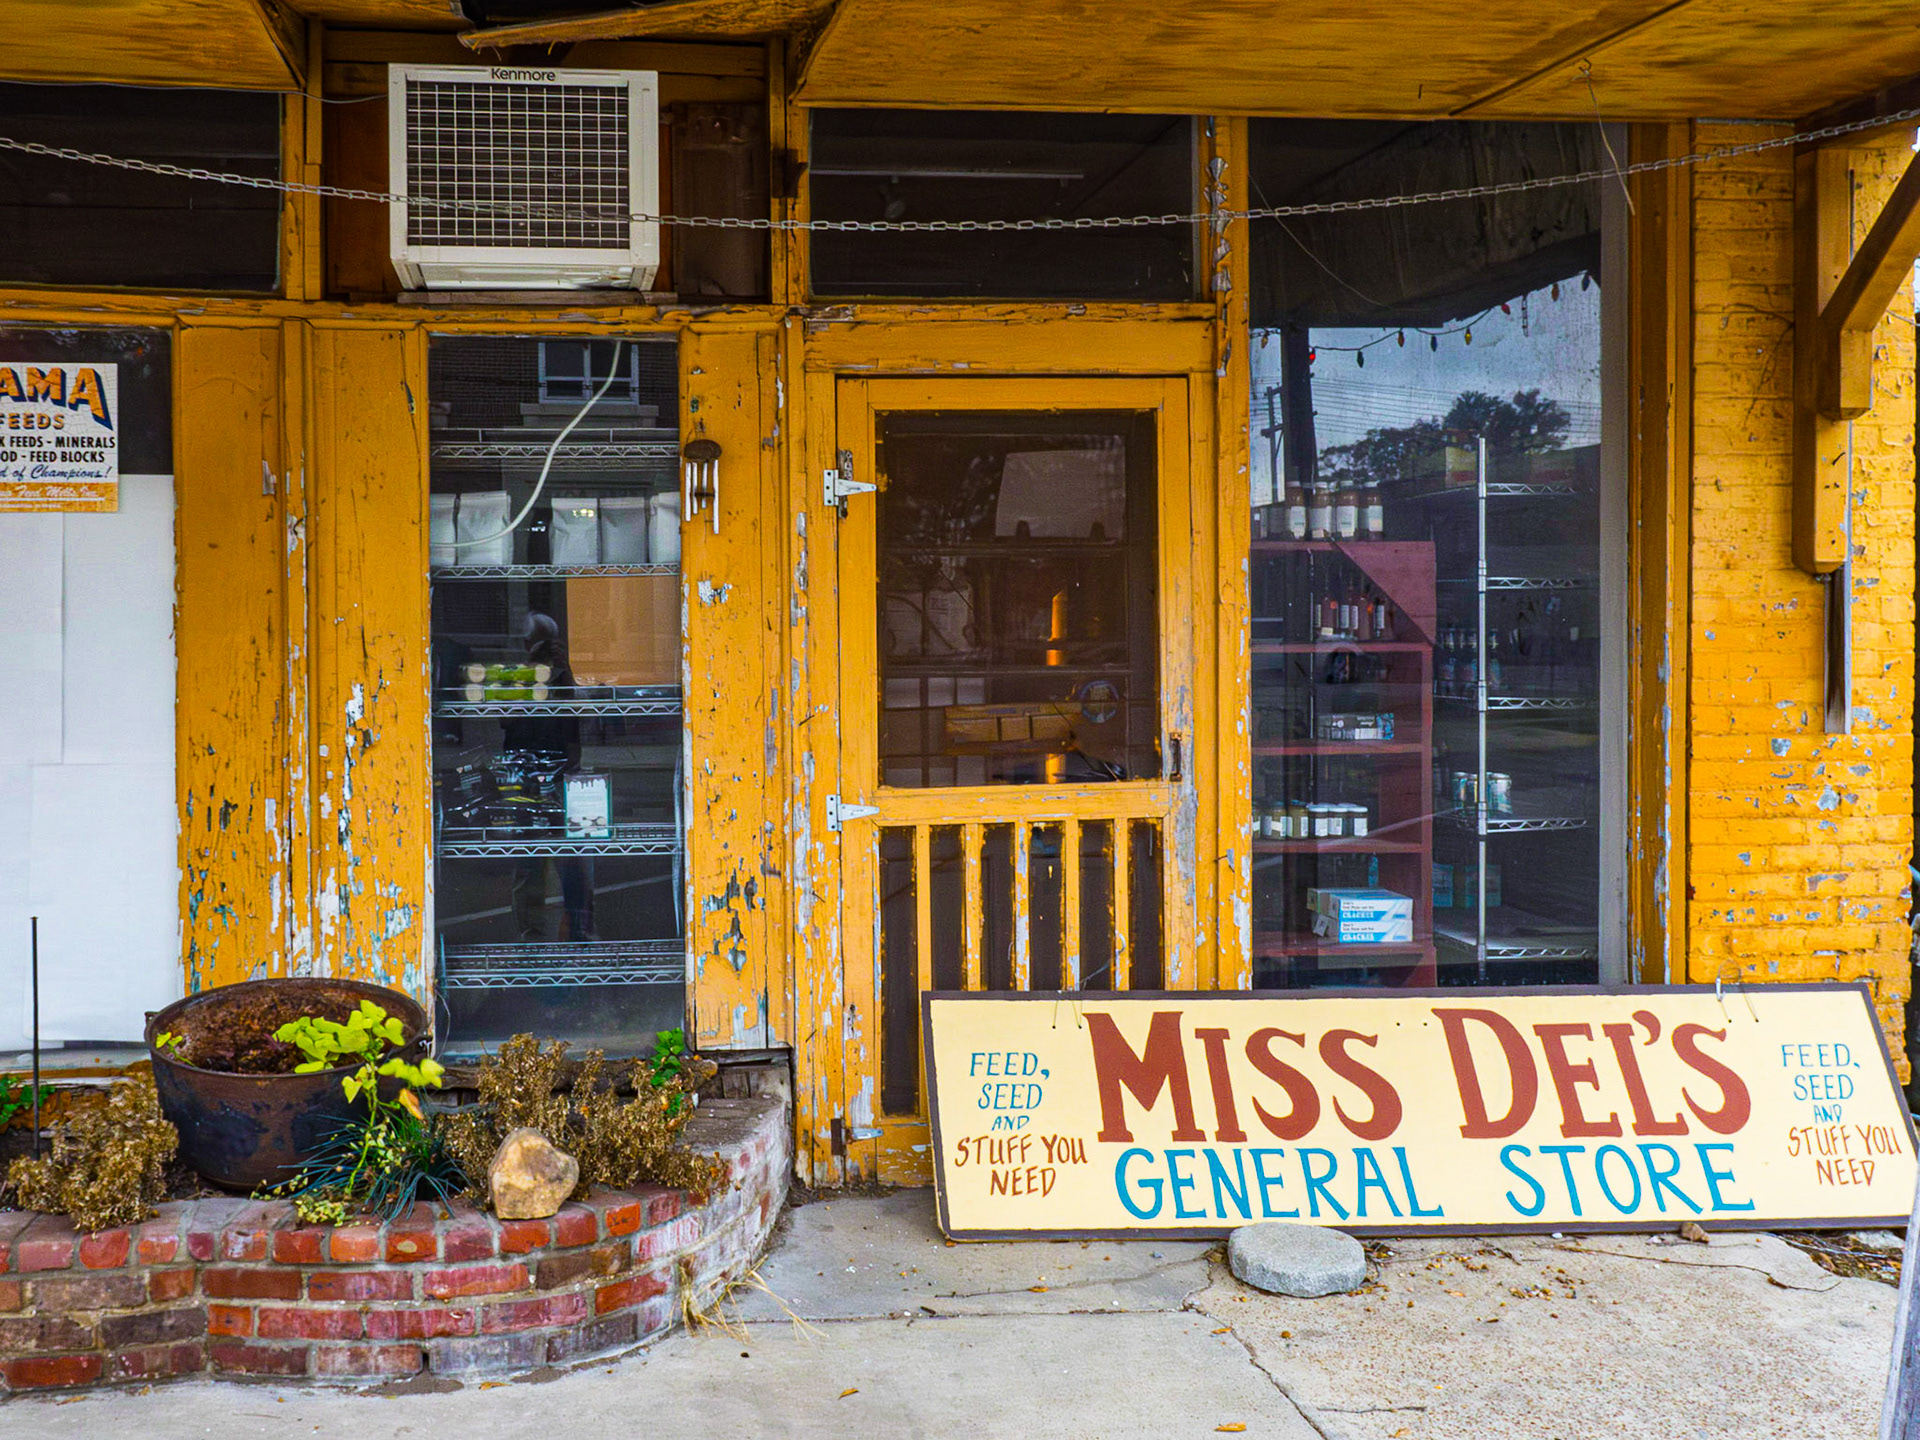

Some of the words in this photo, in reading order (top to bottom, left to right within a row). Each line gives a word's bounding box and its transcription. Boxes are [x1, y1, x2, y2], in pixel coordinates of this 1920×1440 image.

[491, 67, 556, 82] Kenmore
[10, 436, 44, 448] FEEDS
[55, 436, 116, 448] MINERALS
[29, 451, 57, 463] FEED
[60, 451, 105, 463] BLOCKS
[12, 466, 27, 482] of
[30, 464, 113, 480] Champions!
[969, 1052, 1050, 1081] FEED,
[1082, 1011, 1403, 1143] MISS
[1431, 1007, 1751, 1140] DEL'S
[977, 1083, 1043, 1110] SEED
[1793, 1074, 1854, 1101] SEED
[992, 1115, 1030, 1131] AND
[1813, 1104, 1843, 1123] AND
[955, 1133, 1033, 1168] STUFF
[1041, 1133, 1088, 1165] YOU
[1787, 1125, 1851, 1157] STUFF
[1854, 1126, 1903, 1155] YOU
[990, 1166, 1056, 1198] NEED
[1115, 1147, 1444, 1221] GENERAL
[1500, 1142, 1755, 1217] STORE
[1817, 1158, 1875, 1187] NEED
